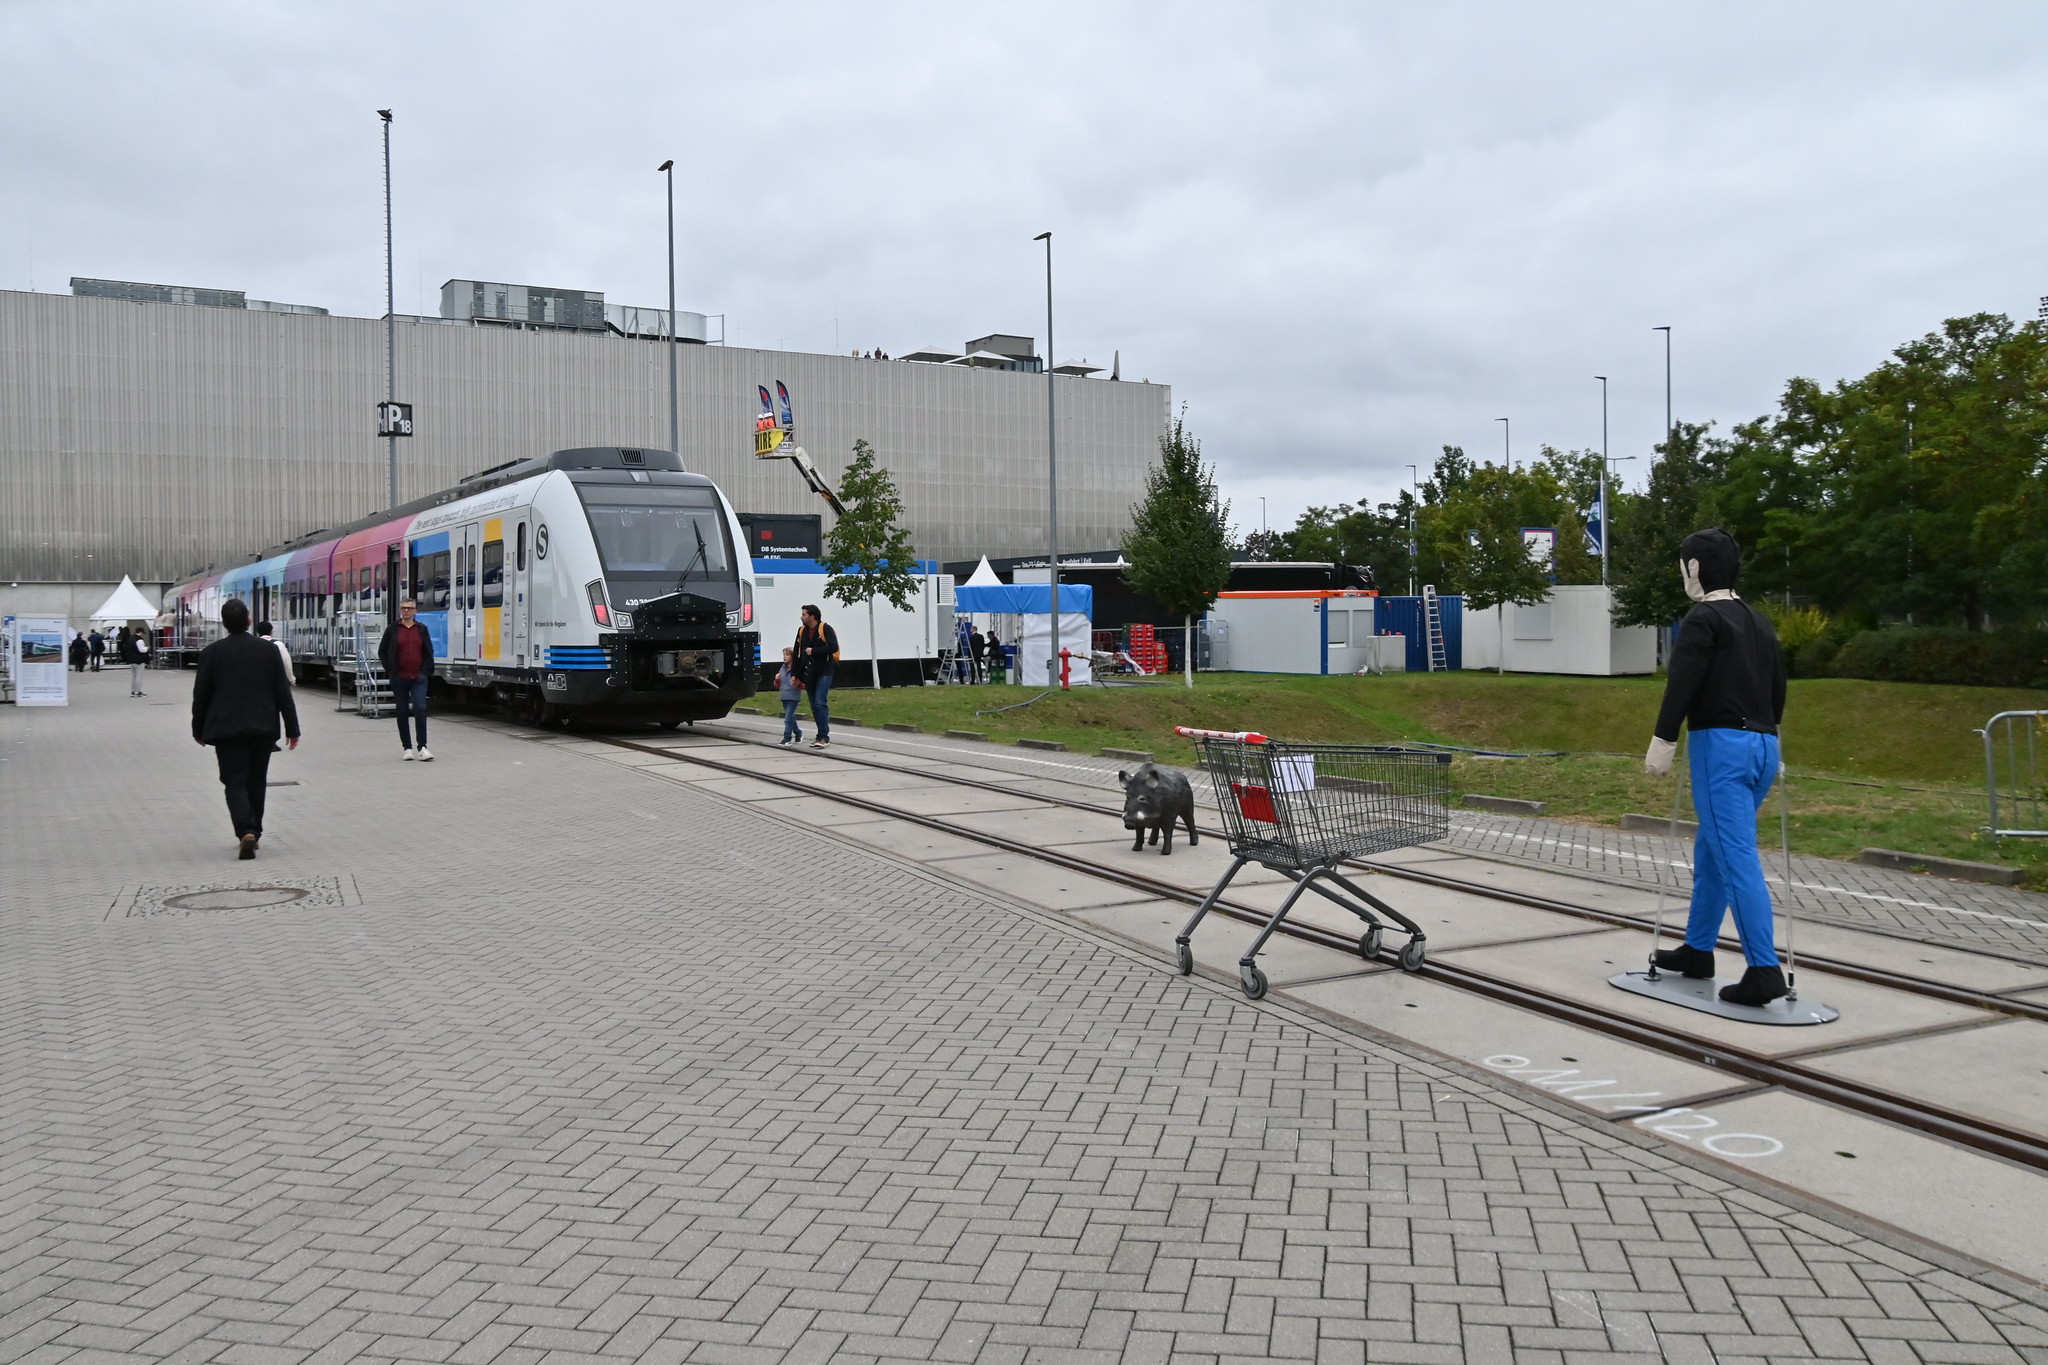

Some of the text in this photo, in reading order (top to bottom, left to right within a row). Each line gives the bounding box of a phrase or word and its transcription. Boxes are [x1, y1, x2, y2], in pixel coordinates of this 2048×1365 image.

[388, 404, 402, 432] P
[399, 419, 412, 434] 18
[625, 598, 639, 606] 430
